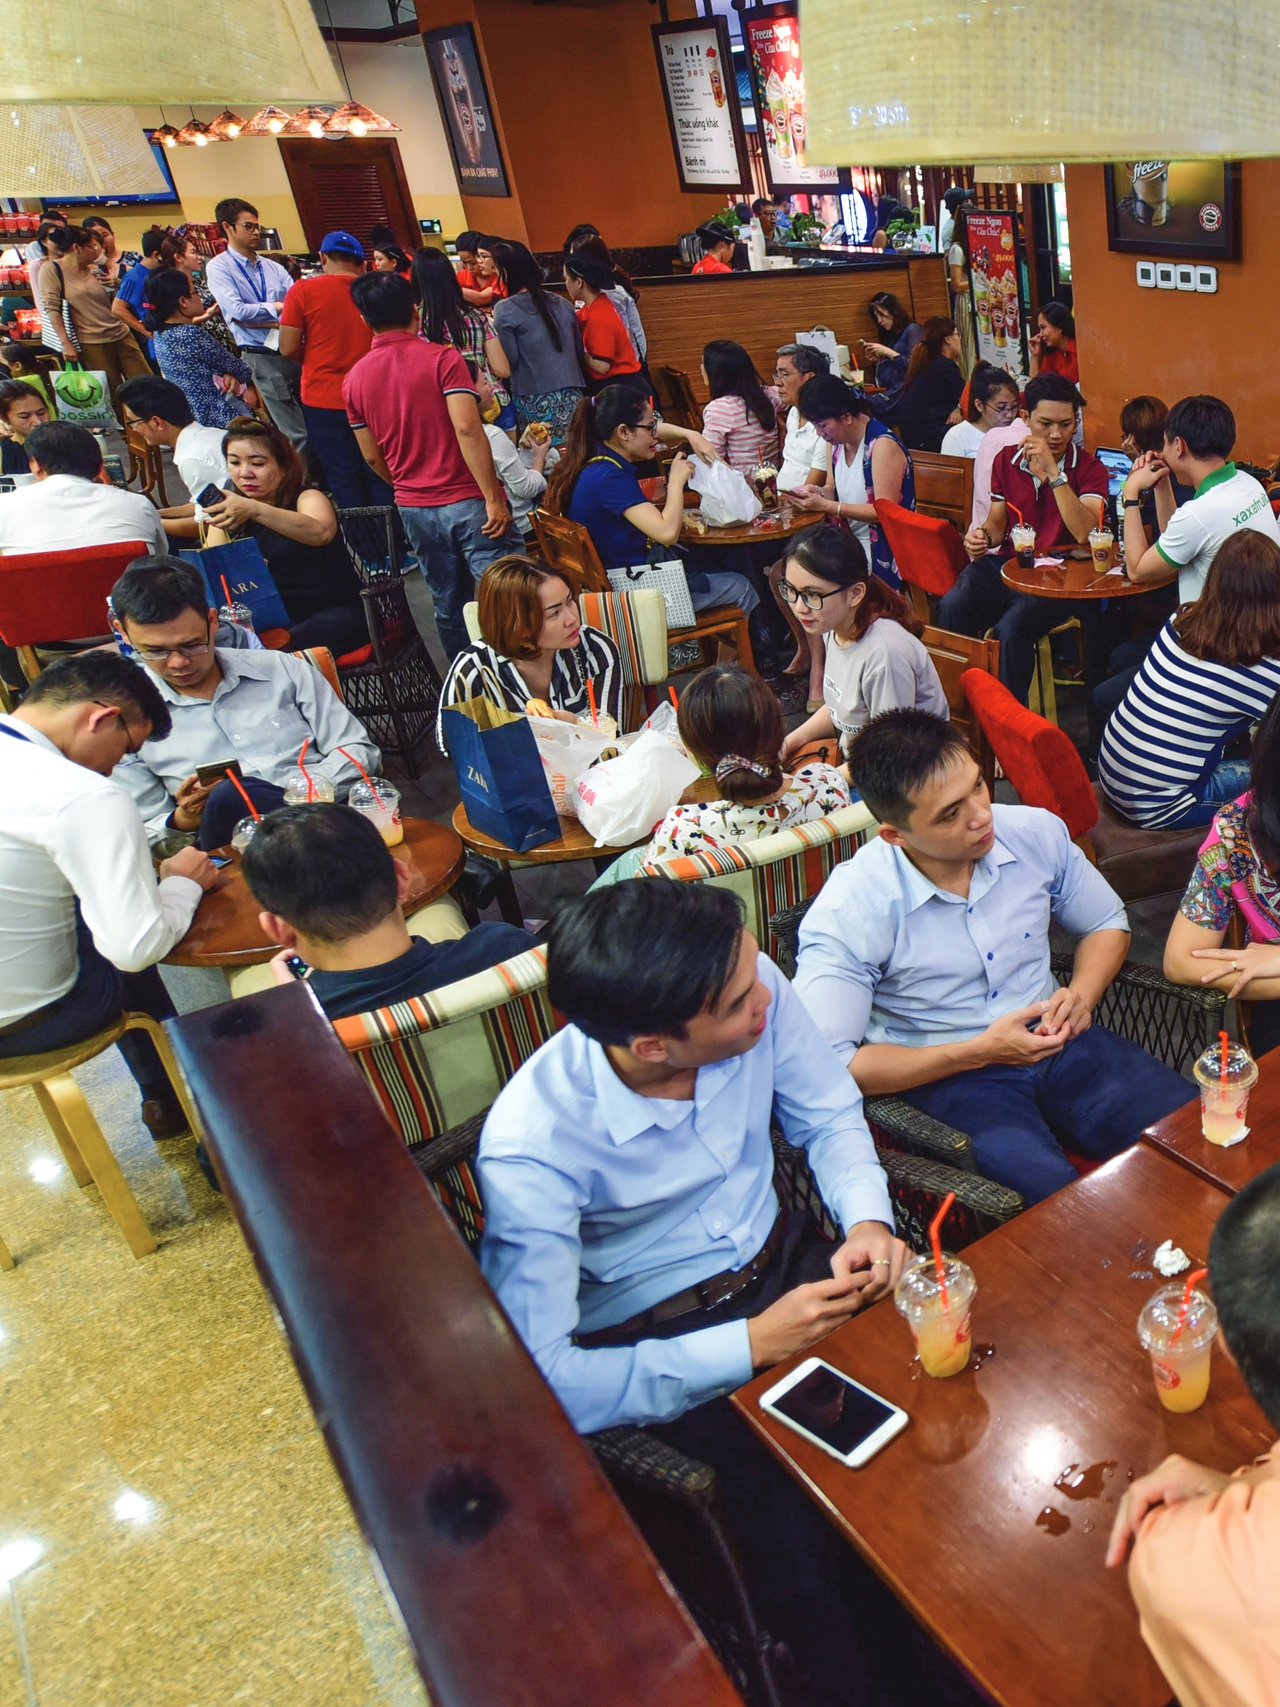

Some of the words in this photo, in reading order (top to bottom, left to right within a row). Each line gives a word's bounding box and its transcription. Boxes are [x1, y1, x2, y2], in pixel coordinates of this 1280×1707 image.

[751, 28, 774, 41] Freeze
[966, 215, 985, 226] Freeze
[985, 215, 1003, 228] Ngon
